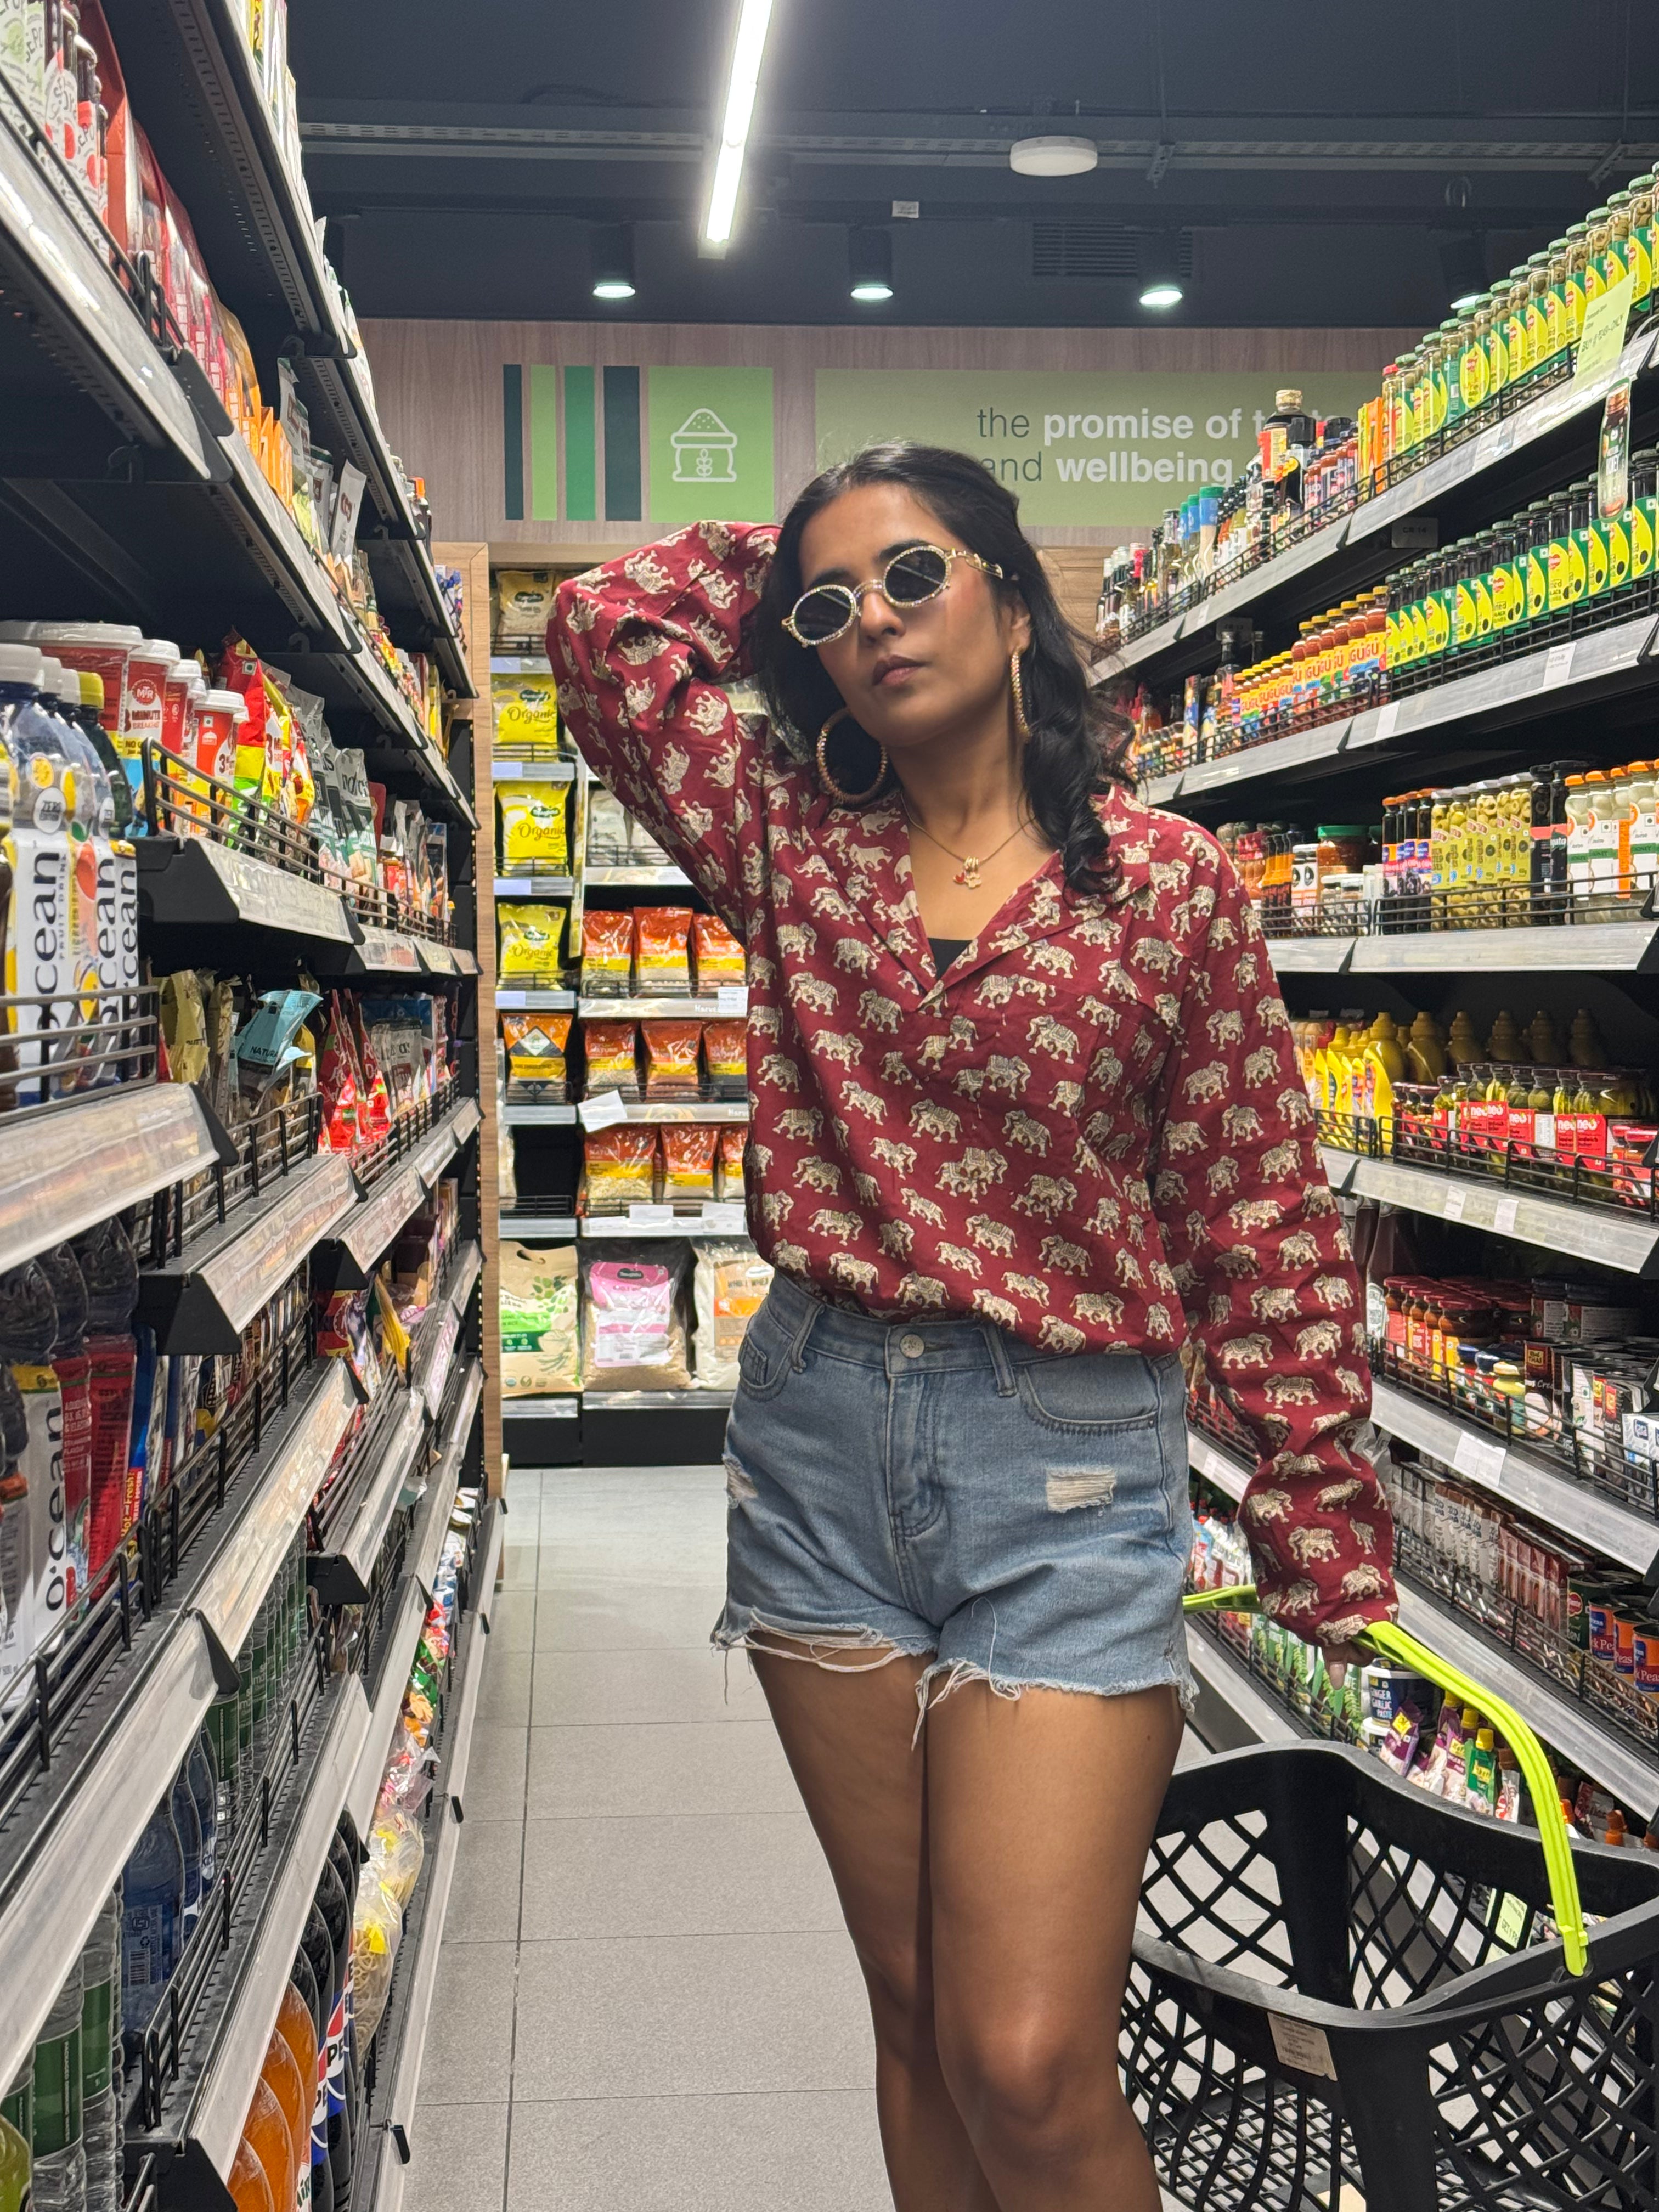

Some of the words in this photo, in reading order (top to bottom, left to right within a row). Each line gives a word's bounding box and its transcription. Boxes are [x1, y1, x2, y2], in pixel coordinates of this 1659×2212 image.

[977, 407, 1030, 438] the
[1044, 408, 1194, 447] promise
[1206, 408, 1242, 439] of
[1056, 451, 1233, 486] wellbeing
[137, 686, 154, 699] MTR
[218, 753, 226, 774] 3
[517, 822, 566, 842] Organic
[58, 853, 66, 902] DRINK
[1576, 1118, 1599, 1131] neo
[123, 1472, 136, 1504] Fresh!
[46, 1406, 65, 1611] O'cean
